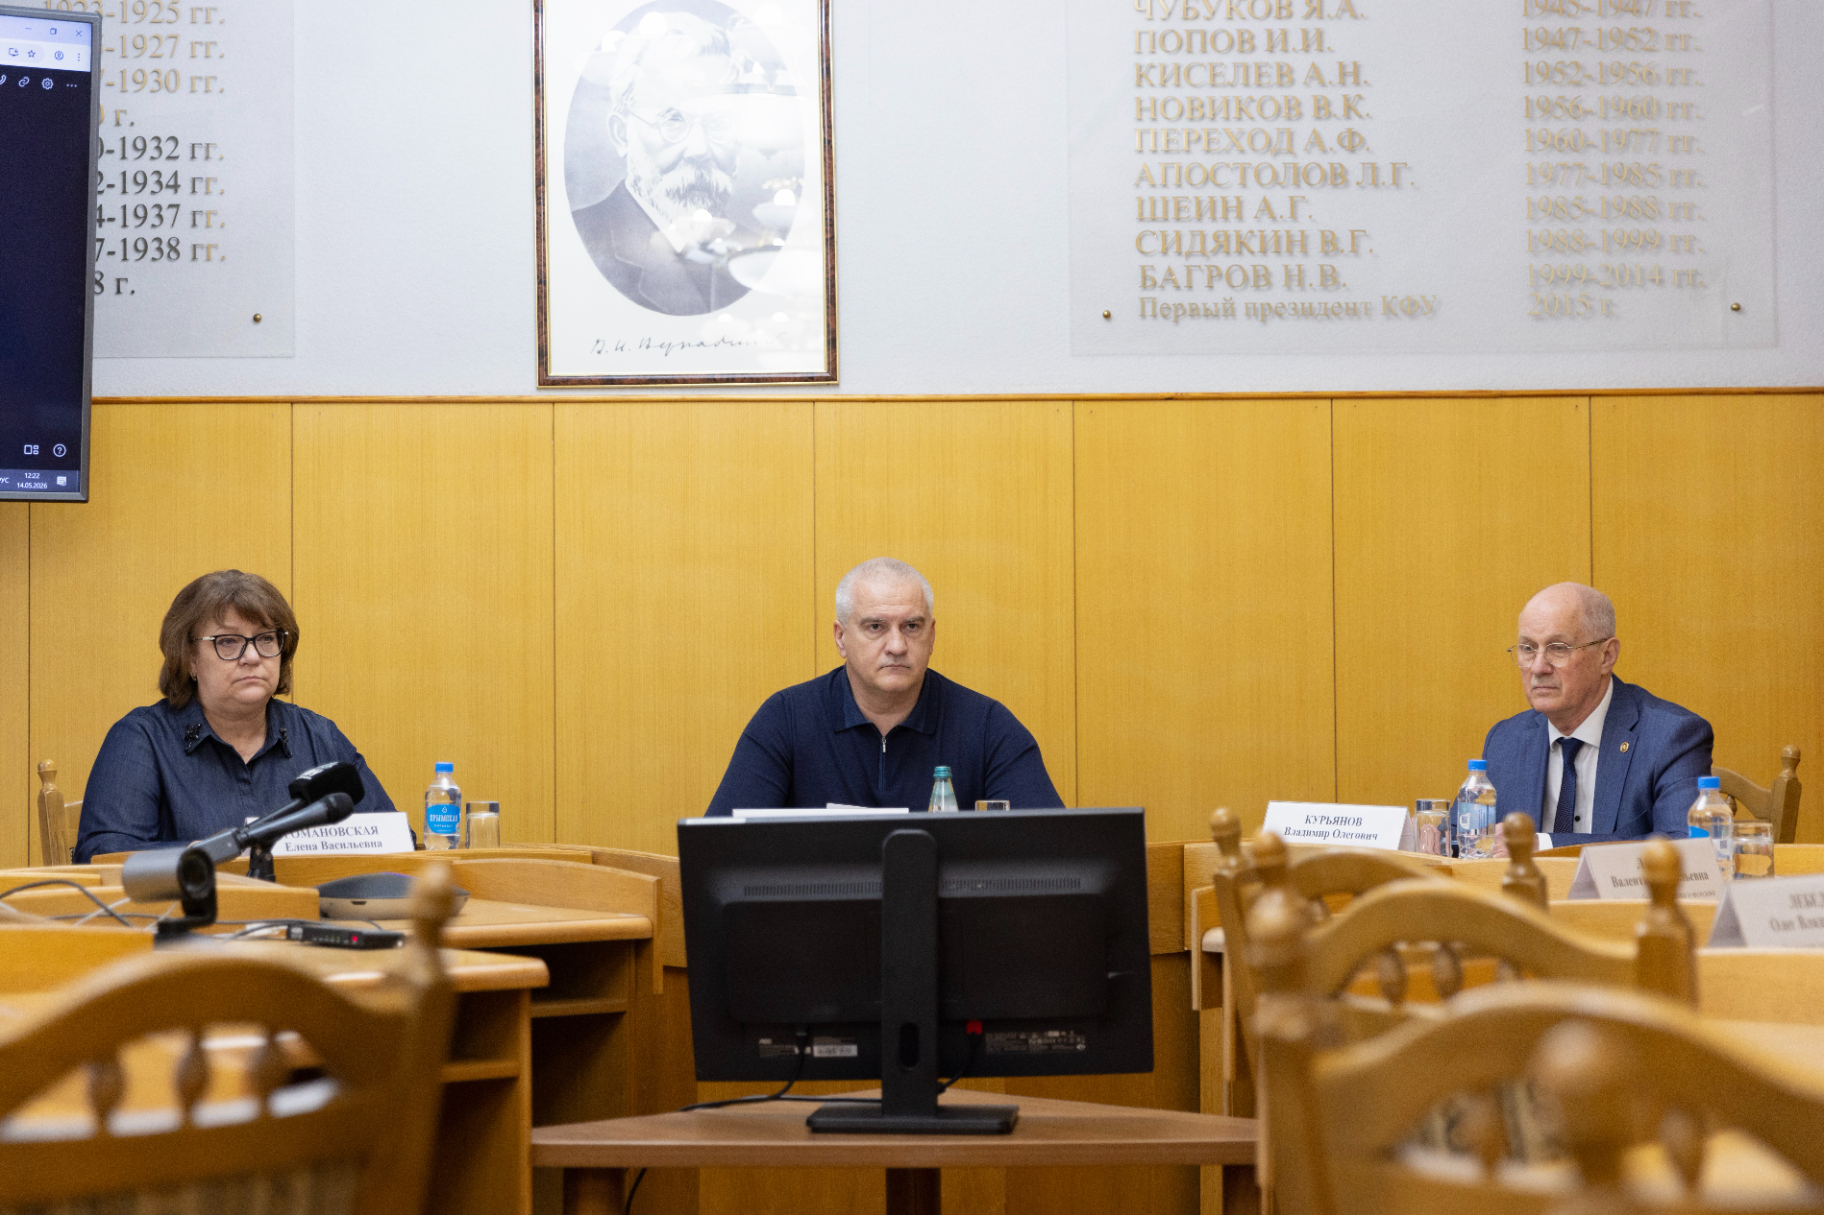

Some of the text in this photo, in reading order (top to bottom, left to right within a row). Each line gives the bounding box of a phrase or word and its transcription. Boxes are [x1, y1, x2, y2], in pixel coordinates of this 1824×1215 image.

[190, 6, 225, 24] гг.
[1134, 0, 1365, 20] ЧУБУКОВ Я.А.
[1523, 0, 1699, 18] 1945-1947 гг.
[101, 34, 225, 59] -1927 гг.
[1134, 28, 1331, 53] ПОПОВ И.И.
[1523, 27, 1699, 51] 1947-1952 гг.
[101, 68, 225, 94] -1930 гг.
[1134, 61, 1368, 87] КИСЕЛЕВ А.Н.
[1524, 61, 1700, 86] 1952-1956 гг.
[1134, 94, 1370, 120] НОВИКОВ В.К.
[1524, 95, 1701, 119] 1956-1960 гг.
[190, 142, 225, 160] гг.
[1134, 127, 1371, 155] ПЕРЕХОД А.Ф.
[1525, 128, 1702, 152] 1960-1977 гг.
[190, 176, 225, 195] гг.
[1133, 162, 1415, 187] АПОСТОЛОВ Л.Г.
[1526, 162, 1703, 187] 1977-1985 гг.
[191, 209, 226, 229] гг.
[1136, 195, 1313, 220] ШЕИН А.Г.
[1526, 196, 1703, 220] 1985-1988 гг.
[191, 243, 226, 262] гг.
[1135, 230, 1374, 258] СИДЯКИН В.Г.
[1527, 229, 1704, 253] 1988-1999 гг.
[1139, 264, 1348, 288] БАГРОВ Н.В.
[1528, 263, 1705, 287] 1999-2014 гг.
[1139, 294, 1437, 322] Первый президент КФУ
[1528, 293, 1591, 317] 2015
[1304, 814, 1363, 827] КУРЬЯНОВ
[1284, 826, 1379, 841] Владимир Олегович
[285, 840, 384, 852] Елена Васильевна
